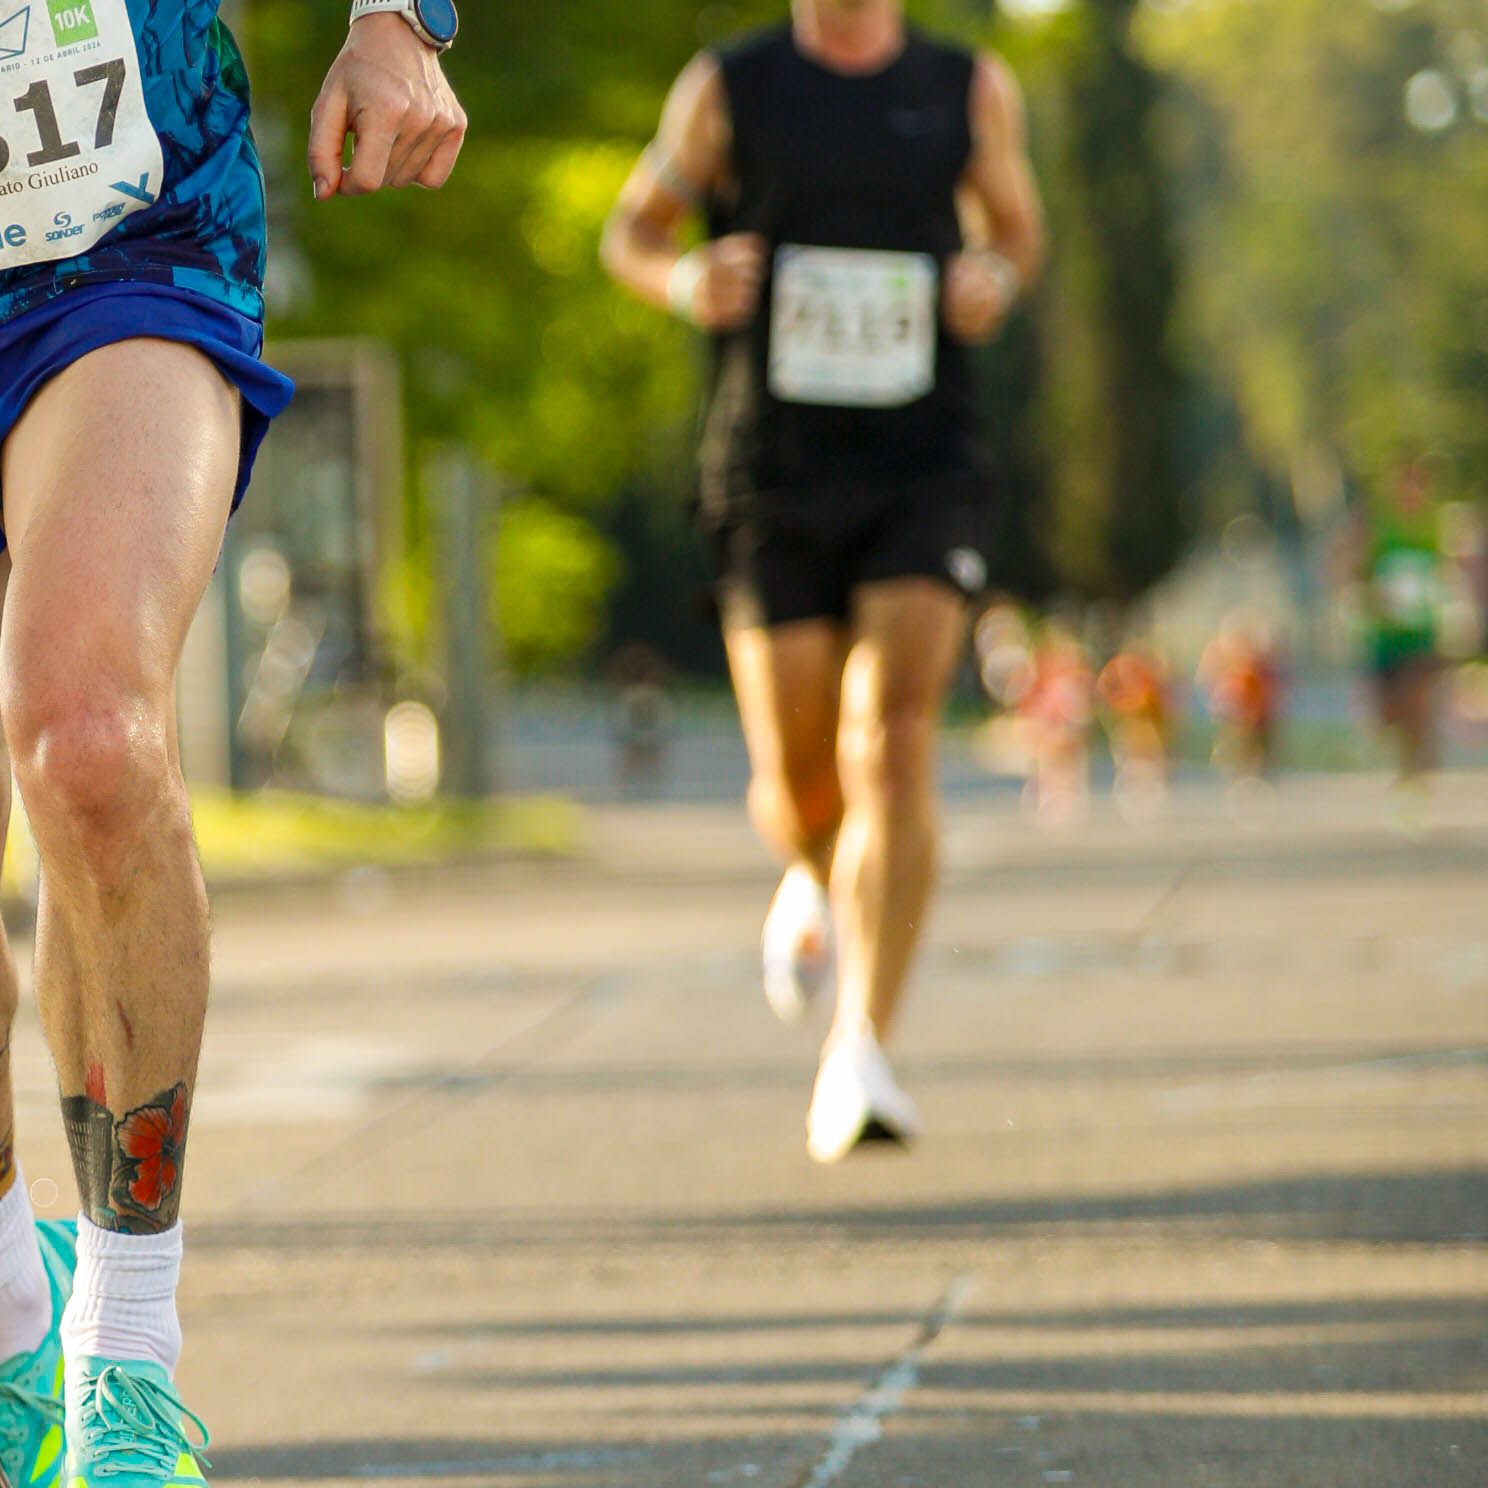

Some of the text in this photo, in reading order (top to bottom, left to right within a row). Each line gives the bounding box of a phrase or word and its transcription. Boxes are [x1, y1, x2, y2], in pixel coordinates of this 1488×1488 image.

[53, 6, 91, 32] 10K
[43, 53, 55, 63] DE
[57, 45, 81, 58] ABRIL
[27, 160, 99, 191] Giuliano
